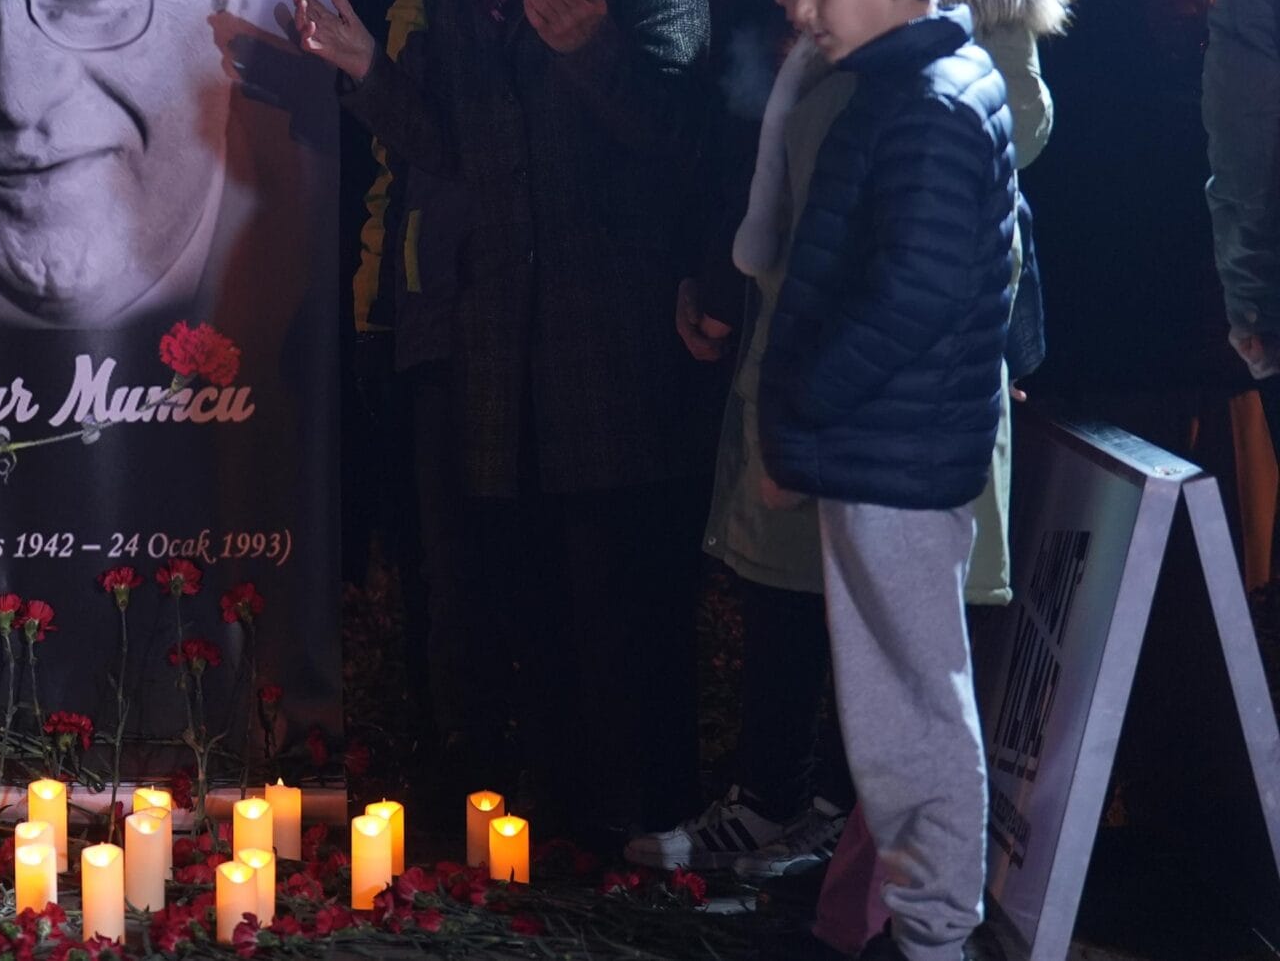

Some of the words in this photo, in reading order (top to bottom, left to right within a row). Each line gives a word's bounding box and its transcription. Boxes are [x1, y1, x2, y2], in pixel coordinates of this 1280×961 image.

[48, 354, 256, 427] Mumcu
[12, 532, 75, 558] 1942
[107, 532, 140, 558] 24
[147, 528, 217, 565] Ocak
[220, 528, 292, 567] 1993)
